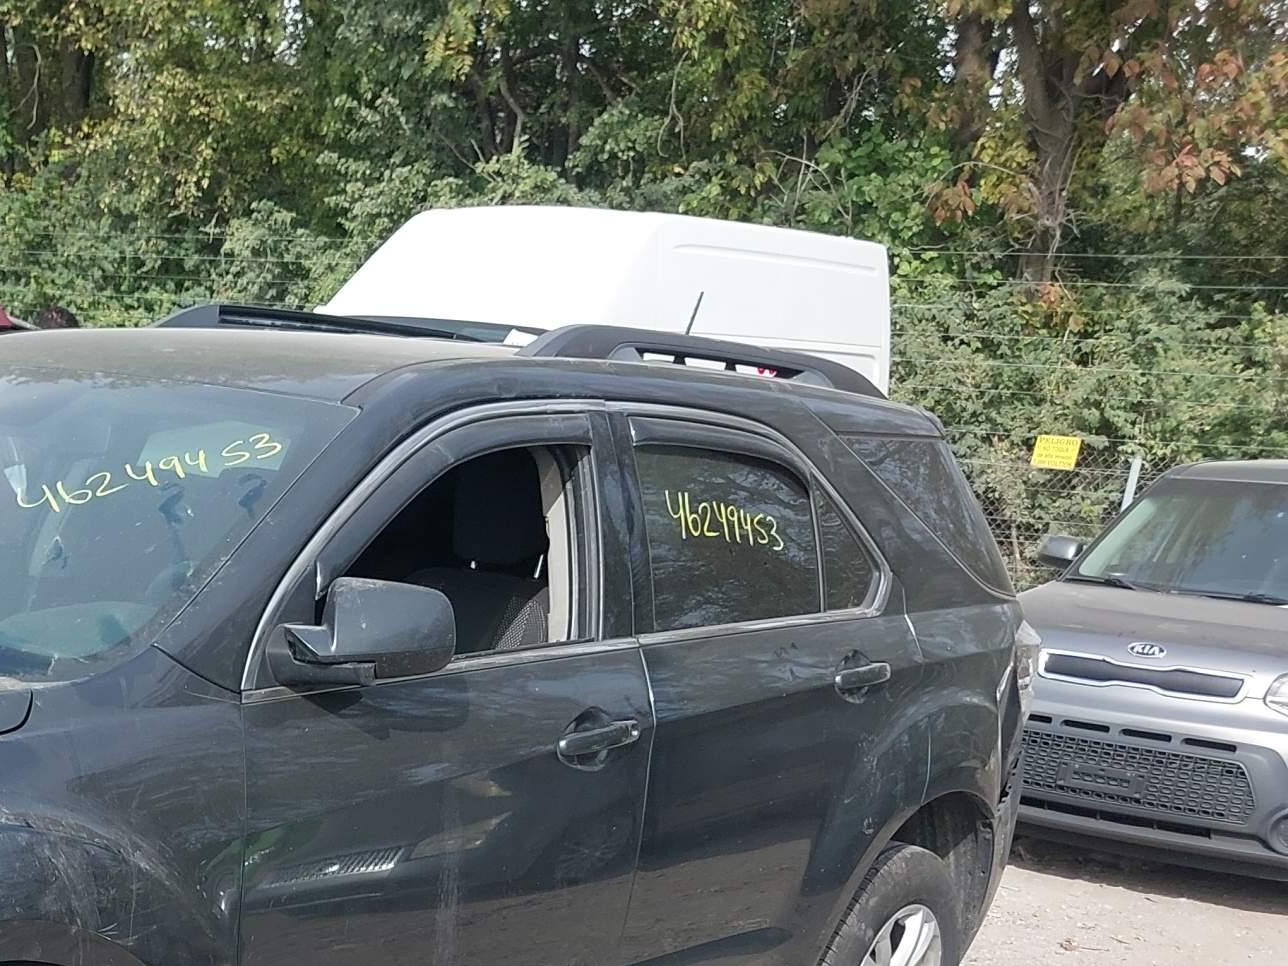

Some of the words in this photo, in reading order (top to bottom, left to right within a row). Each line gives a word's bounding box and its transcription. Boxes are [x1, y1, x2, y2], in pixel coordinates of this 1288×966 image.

[16, 432, 282, 513] 46249453
[664, 489, 785, 551] 46249453
[1132, 644, 1160, 656] KIA
